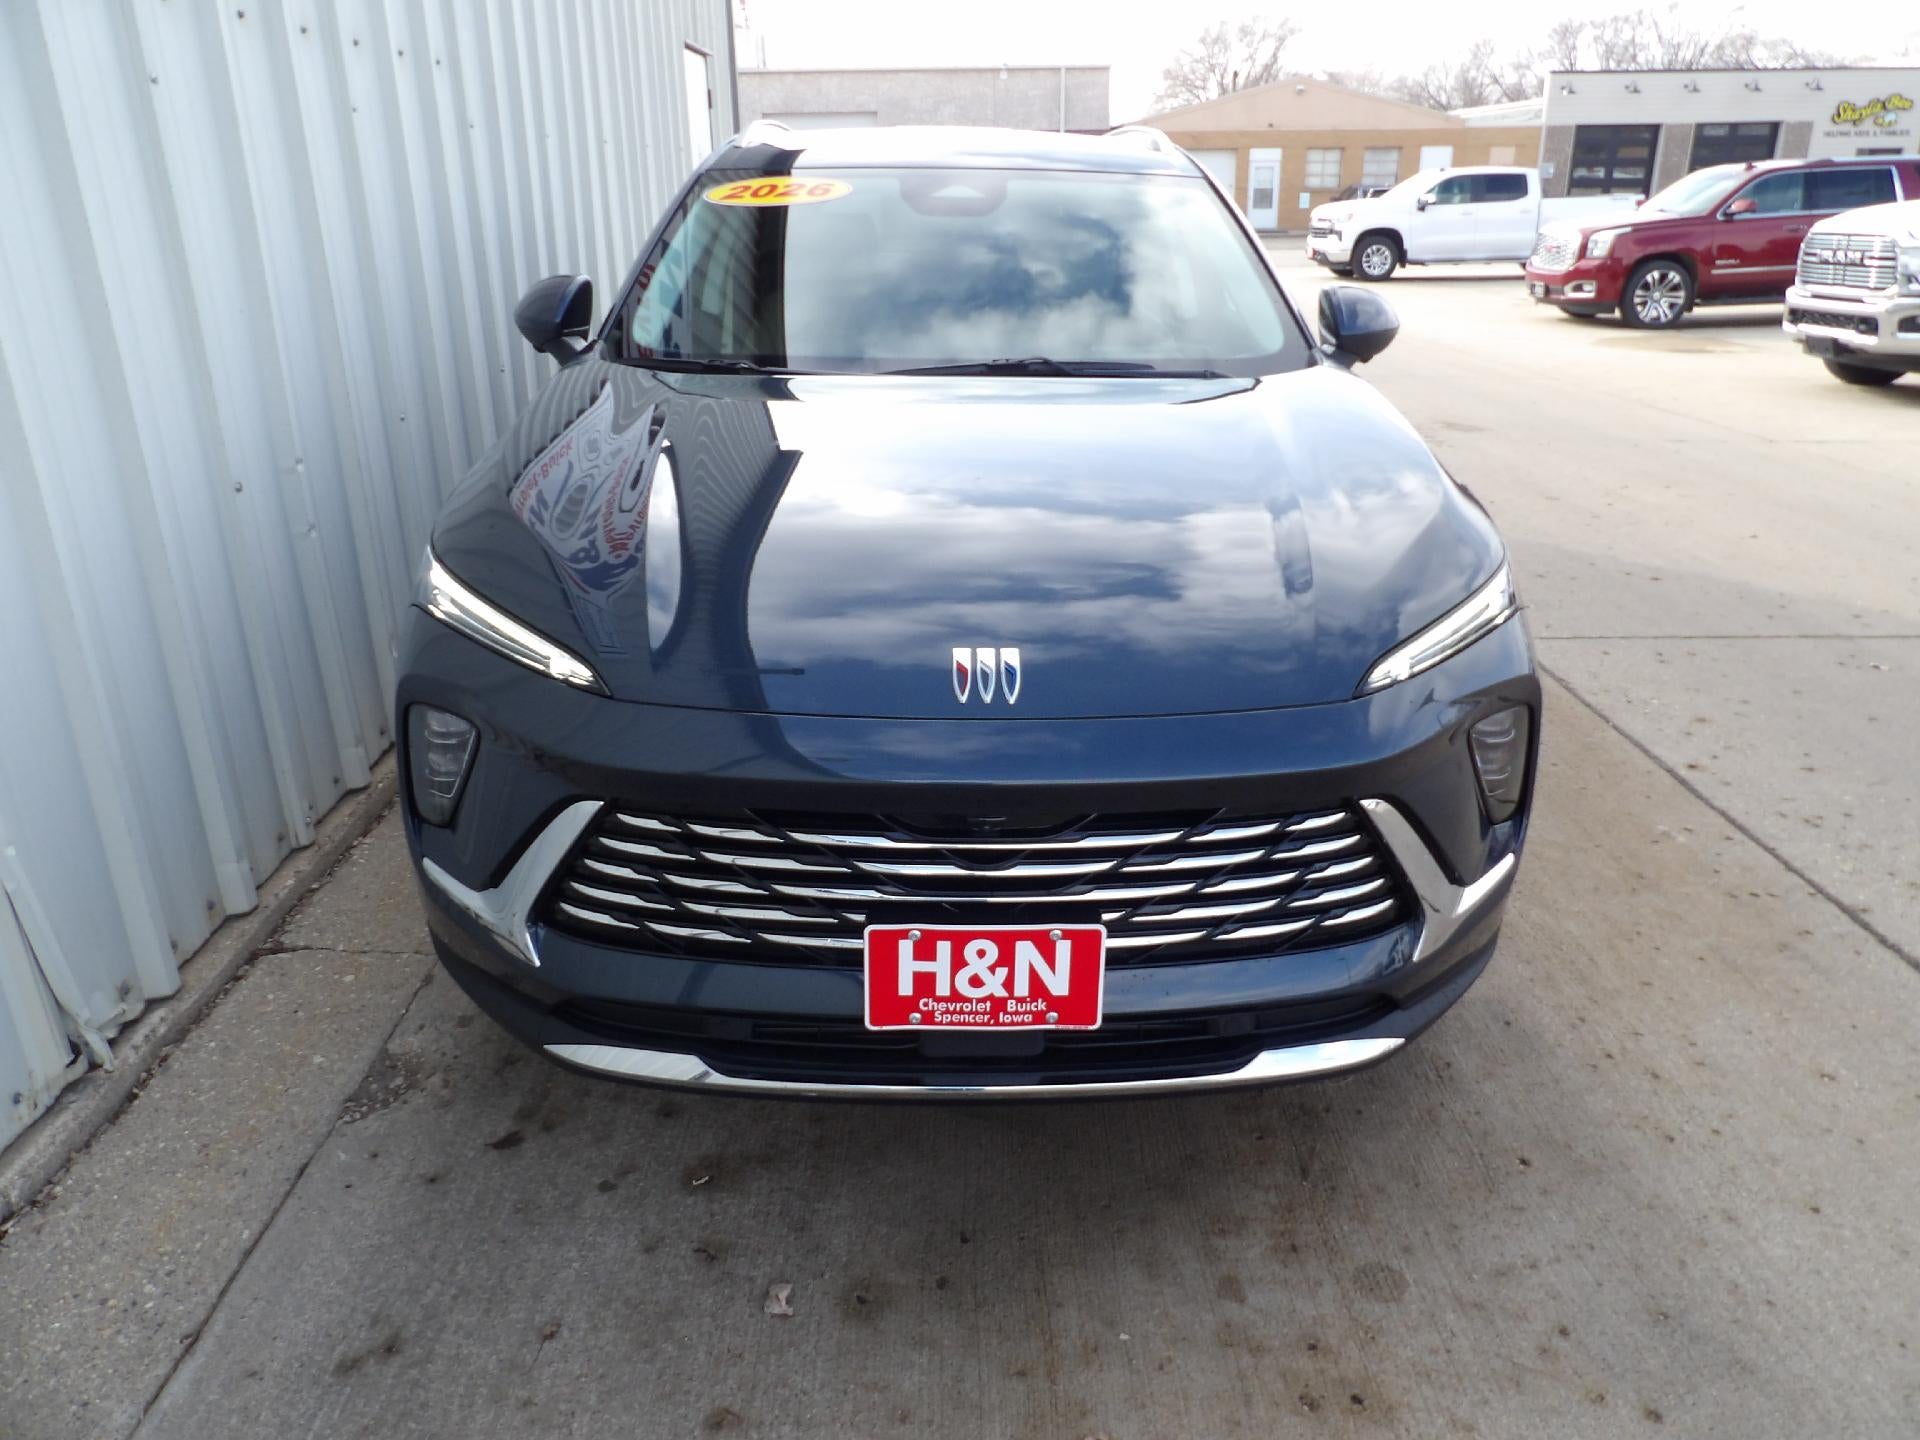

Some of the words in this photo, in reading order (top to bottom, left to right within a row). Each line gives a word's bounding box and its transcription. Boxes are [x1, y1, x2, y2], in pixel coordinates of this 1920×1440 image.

[720, 183, 836, 201] 2026
[898, 938, 1073, 999] H&N
[918, 997, 992, 1013] Chevrolet
[1006, 998, 1048, 1013] Buick
[933, 1010, 995, 1025] Spencer,
[998, 1011, 1034, 1024] Iowa
